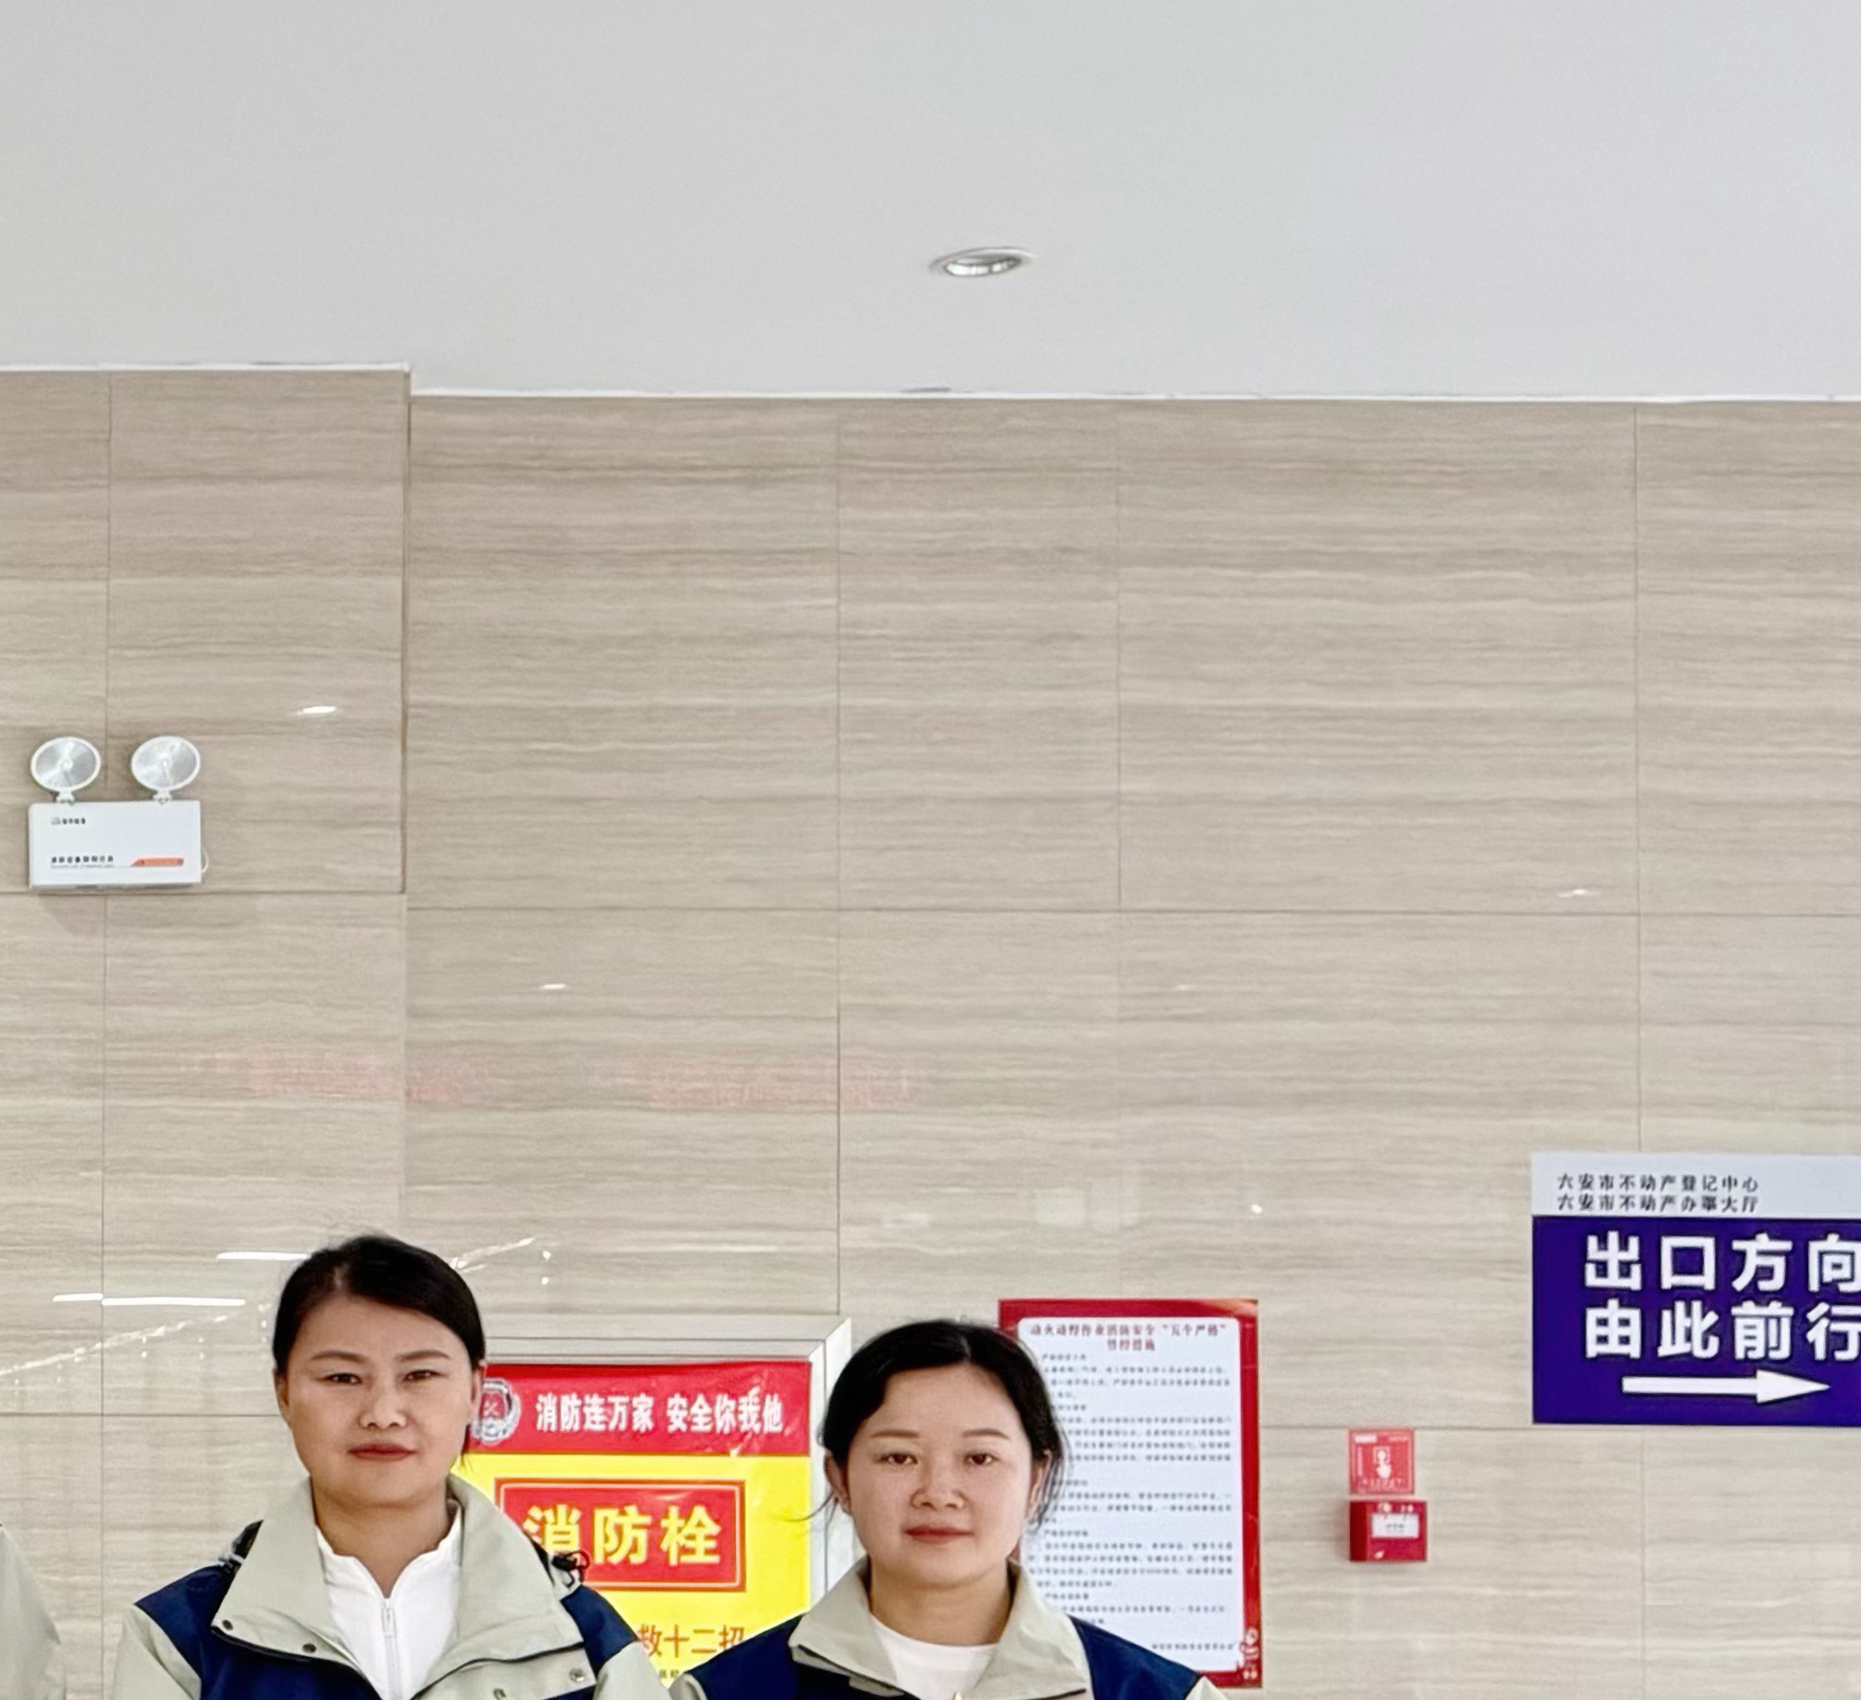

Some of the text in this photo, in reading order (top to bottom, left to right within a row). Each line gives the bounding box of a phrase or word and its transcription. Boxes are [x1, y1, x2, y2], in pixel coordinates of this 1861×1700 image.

[1557, 1173, 1759, 1193] 六安市不动产登记中心
[1584, 1230, 1861, 1292] 出口方向
[1584, 1298, 1861, 1361] 由此前行
[535, 1391, 784, 1433] 消防连万家 安全你我他
[523, 1504, 722, 1567] 消防栓
